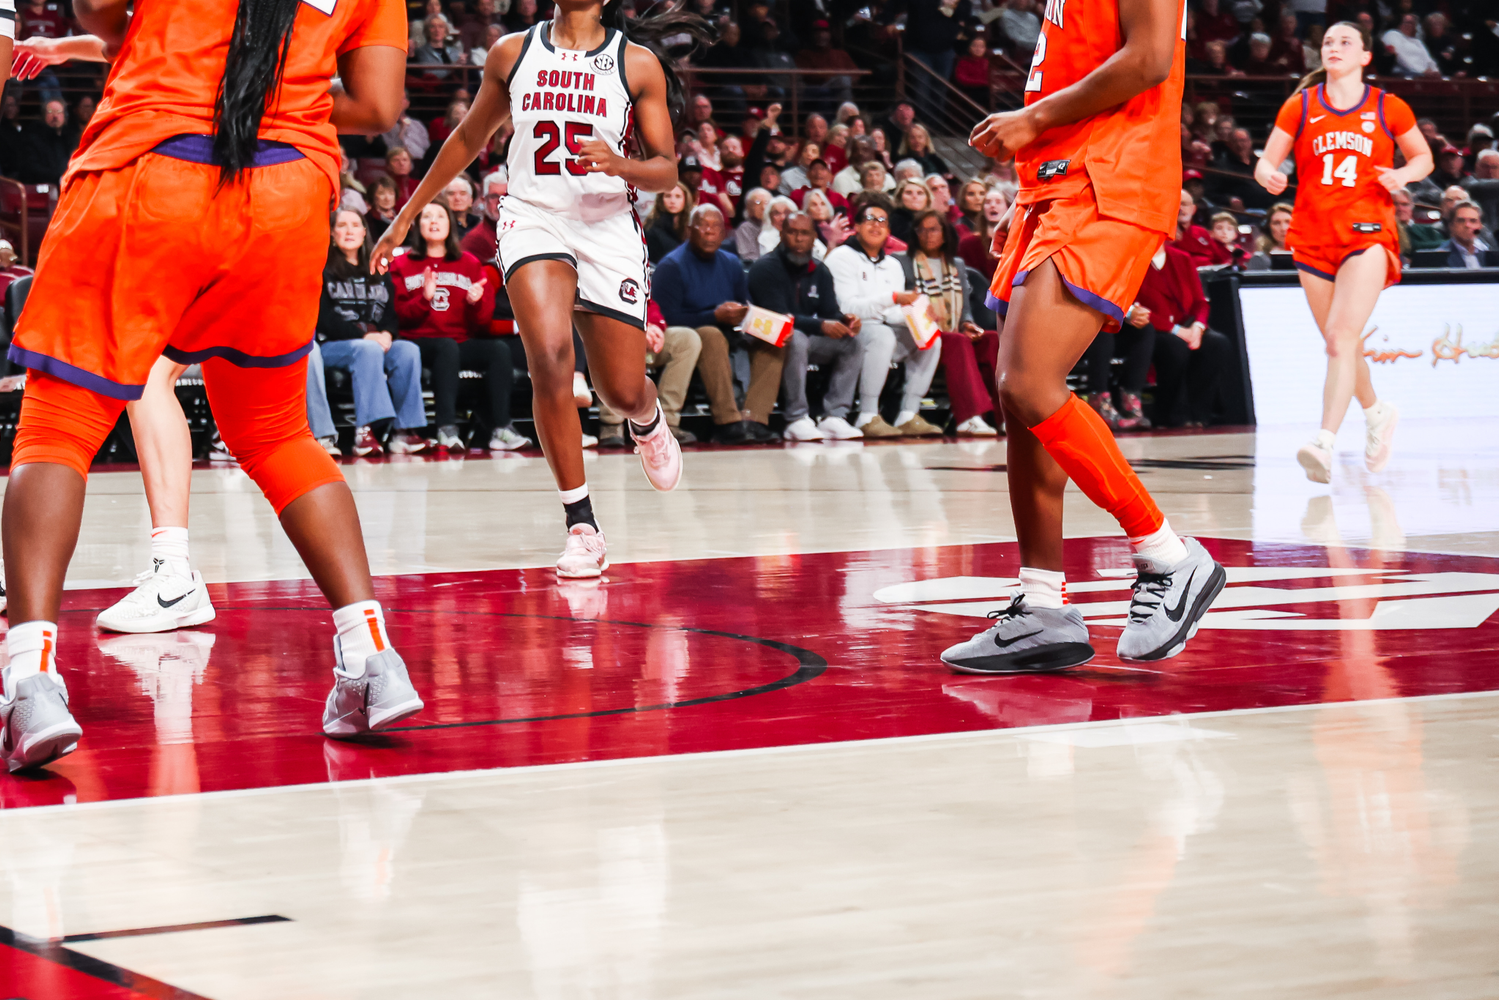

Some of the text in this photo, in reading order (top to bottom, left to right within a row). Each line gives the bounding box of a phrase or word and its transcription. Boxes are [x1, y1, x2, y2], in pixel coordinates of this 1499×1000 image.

[536, 69, 596, 92] SOUTH
[521, 91, 608, 118] CAROLINA
[533, 120, 594, 177] 25
[1312, 130, 1373, 158] CLEMSON
[1320, 153, 1358, 188] 14
